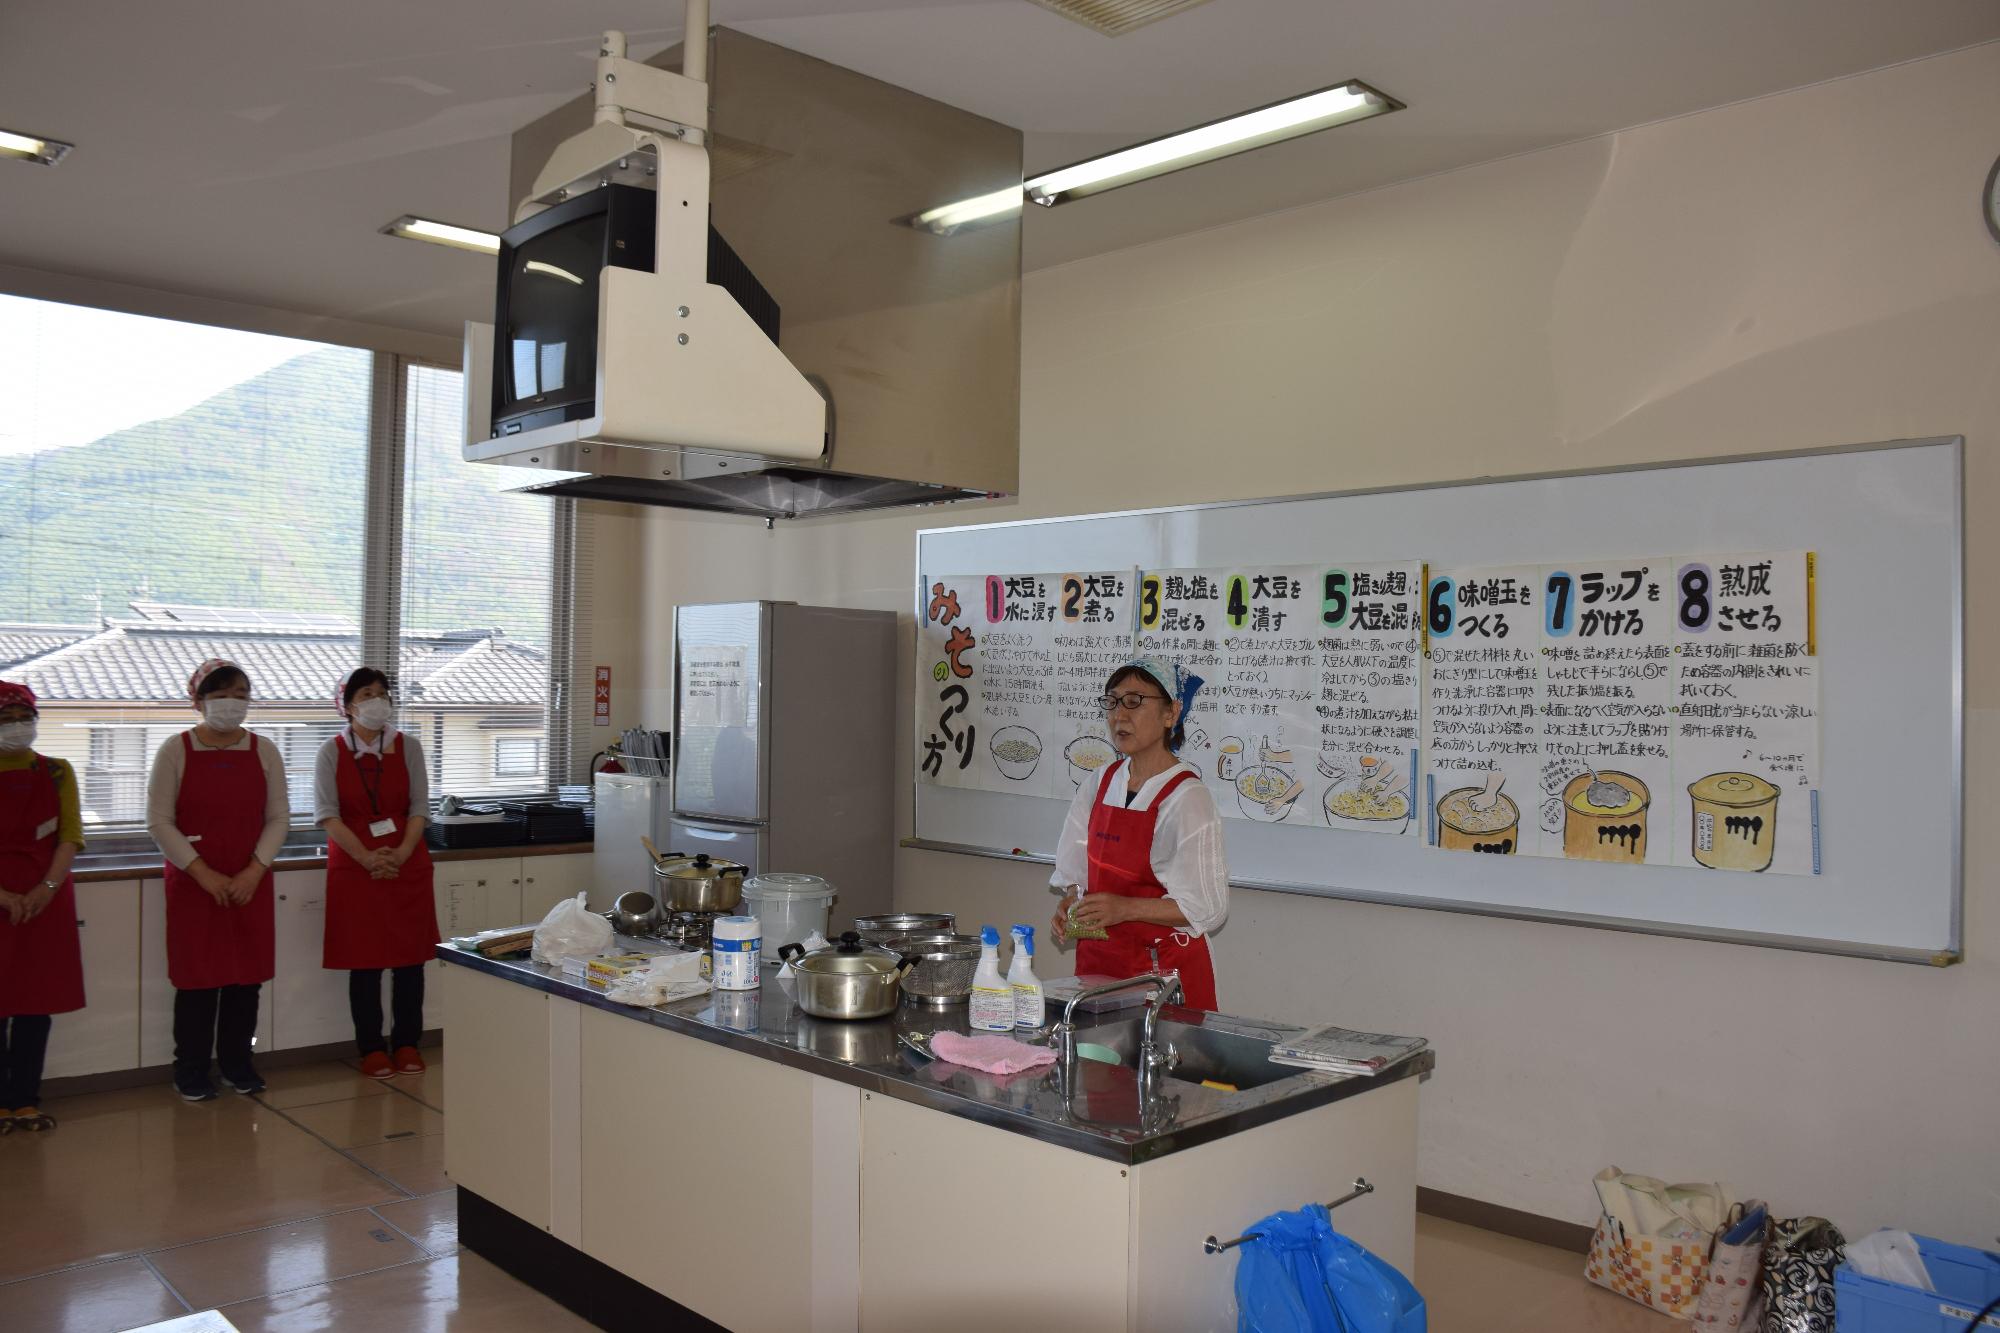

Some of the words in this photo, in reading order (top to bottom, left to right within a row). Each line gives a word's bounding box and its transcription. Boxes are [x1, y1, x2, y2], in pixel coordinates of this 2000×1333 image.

[1005, 577, 1046, 598] 大豆を
[1083, 575, 1124, 597] 大豆を
[1165, 575, 1219, 601] 麹と塩を
[1252, 574, 1301, 599] 大豆を
[1580, 567, 1660, 603] ラップを
[1719, 560, 1772, 596] 熟成
[1064, 579, 1082, 618] 2
[1143, 580, 1159, 625] 3
[1227, 577, 1247, 625] 4
[1323, 573, 1347, 623] 5
[1457, 578, 1531, 607] 味噌玉を
[1548, 576, 1572, 630] 7
[1680, 569, 1709, 628] 8
[1003, 602, 1057, 622] 水に浸す
[1083, 601, 1115, 622] 煮る
[1161, 607, 1205, 631] 混ぜる
[1252, 606, 1287, 631] 潰す
[1429, 580, 1452, 634] 6
[1718, 605, 1781, 633] させる
[1457, 613, 1509, 638] つくる
[1579, 609, 1643, 637] かける
[597, 669, 608, 713] 消火器
